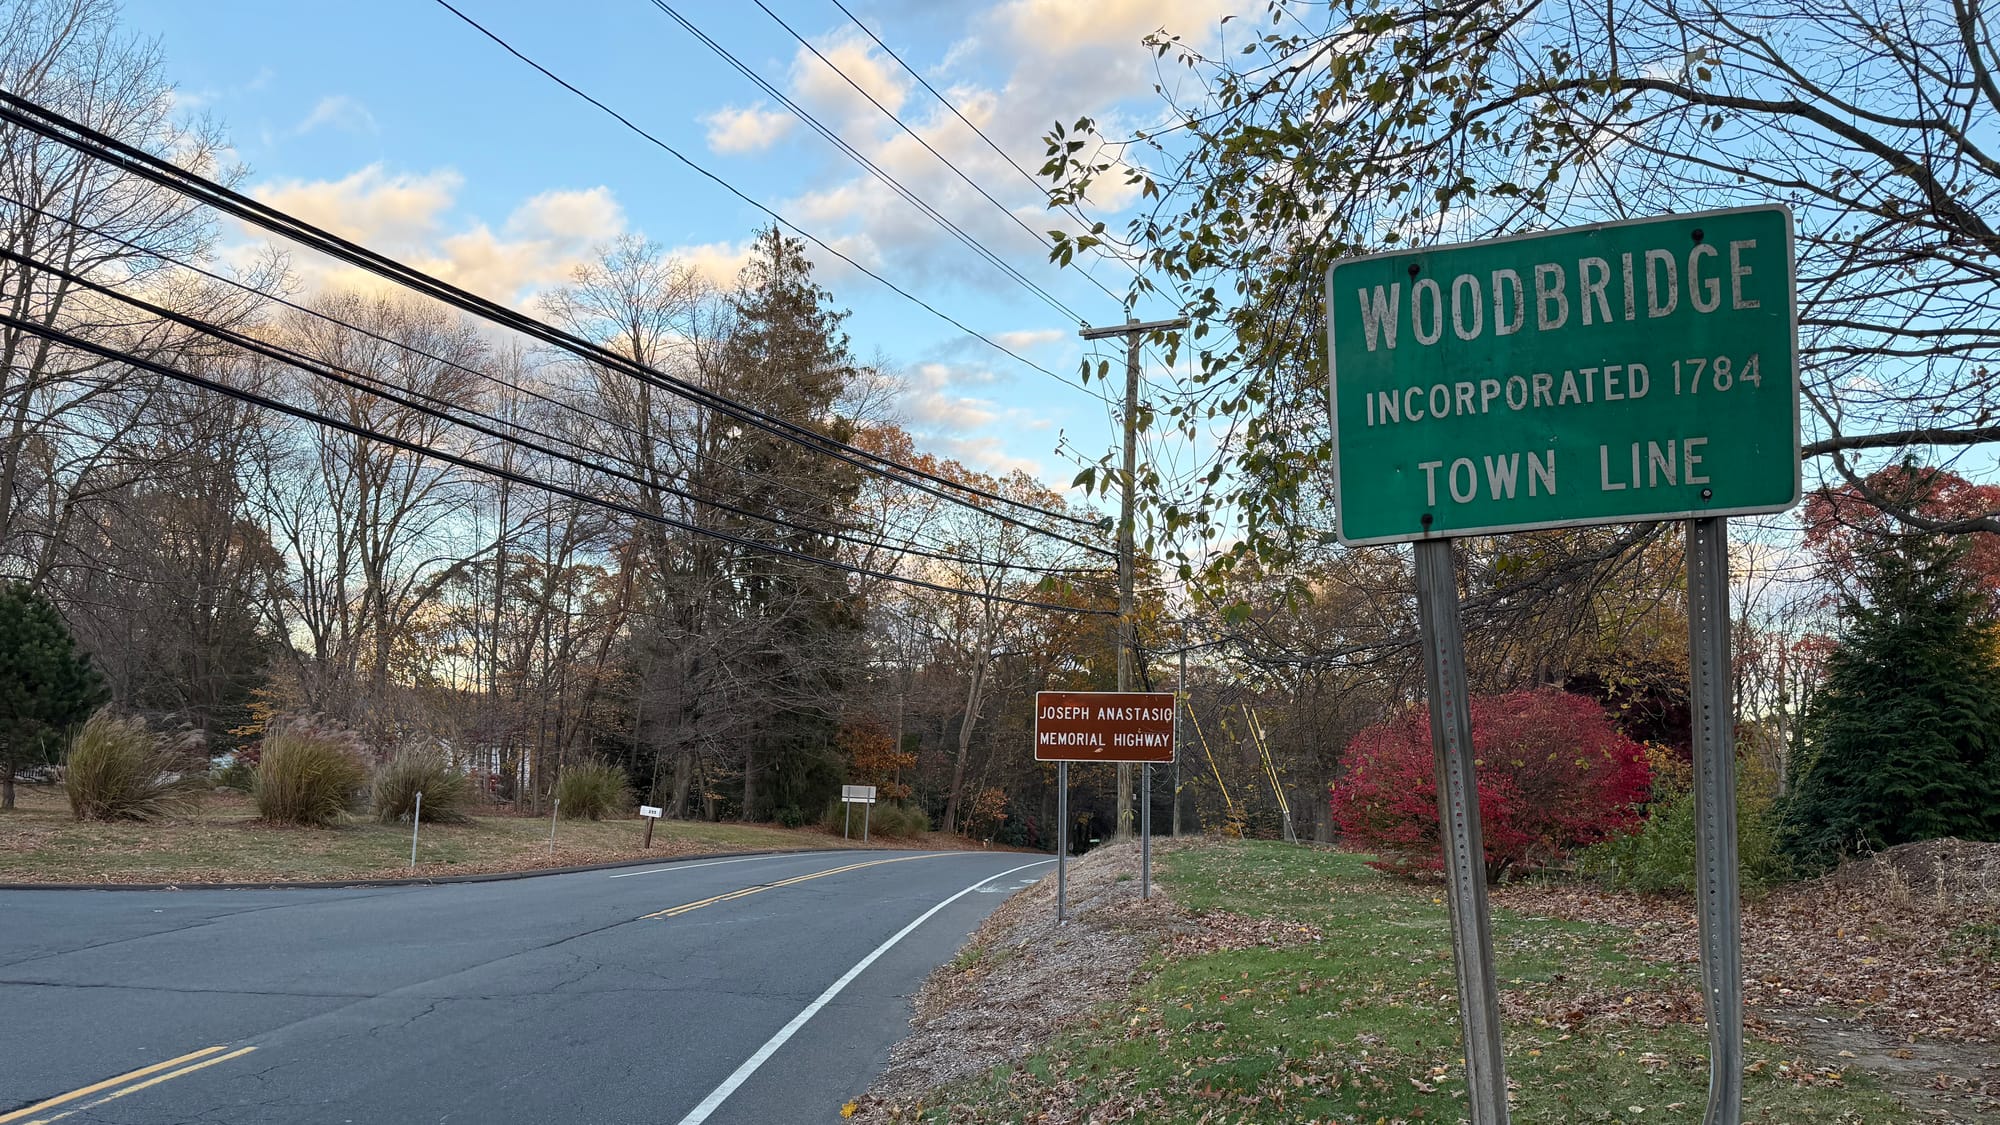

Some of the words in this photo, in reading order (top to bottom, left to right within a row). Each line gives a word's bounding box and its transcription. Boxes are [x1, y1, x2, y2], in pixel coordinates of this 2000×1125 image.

[1358, 239, 1760, 352] WOODBRIDGE
[1366, 363, 1650, 426] INCORPORATED
[1672, 353, 1762, 395] 1784
[1418, 449, 1557, 506] TOWN
[1600, 437, 1711, 490] LINE
[1040, 706, 1089, 720] JOSEPH
[1097, 707, 1172, 721] ANASTASIO
[1040, 732, 1105, 746] MEMORIAL
[1114, 733, 1170, 747] HIGHWAY
